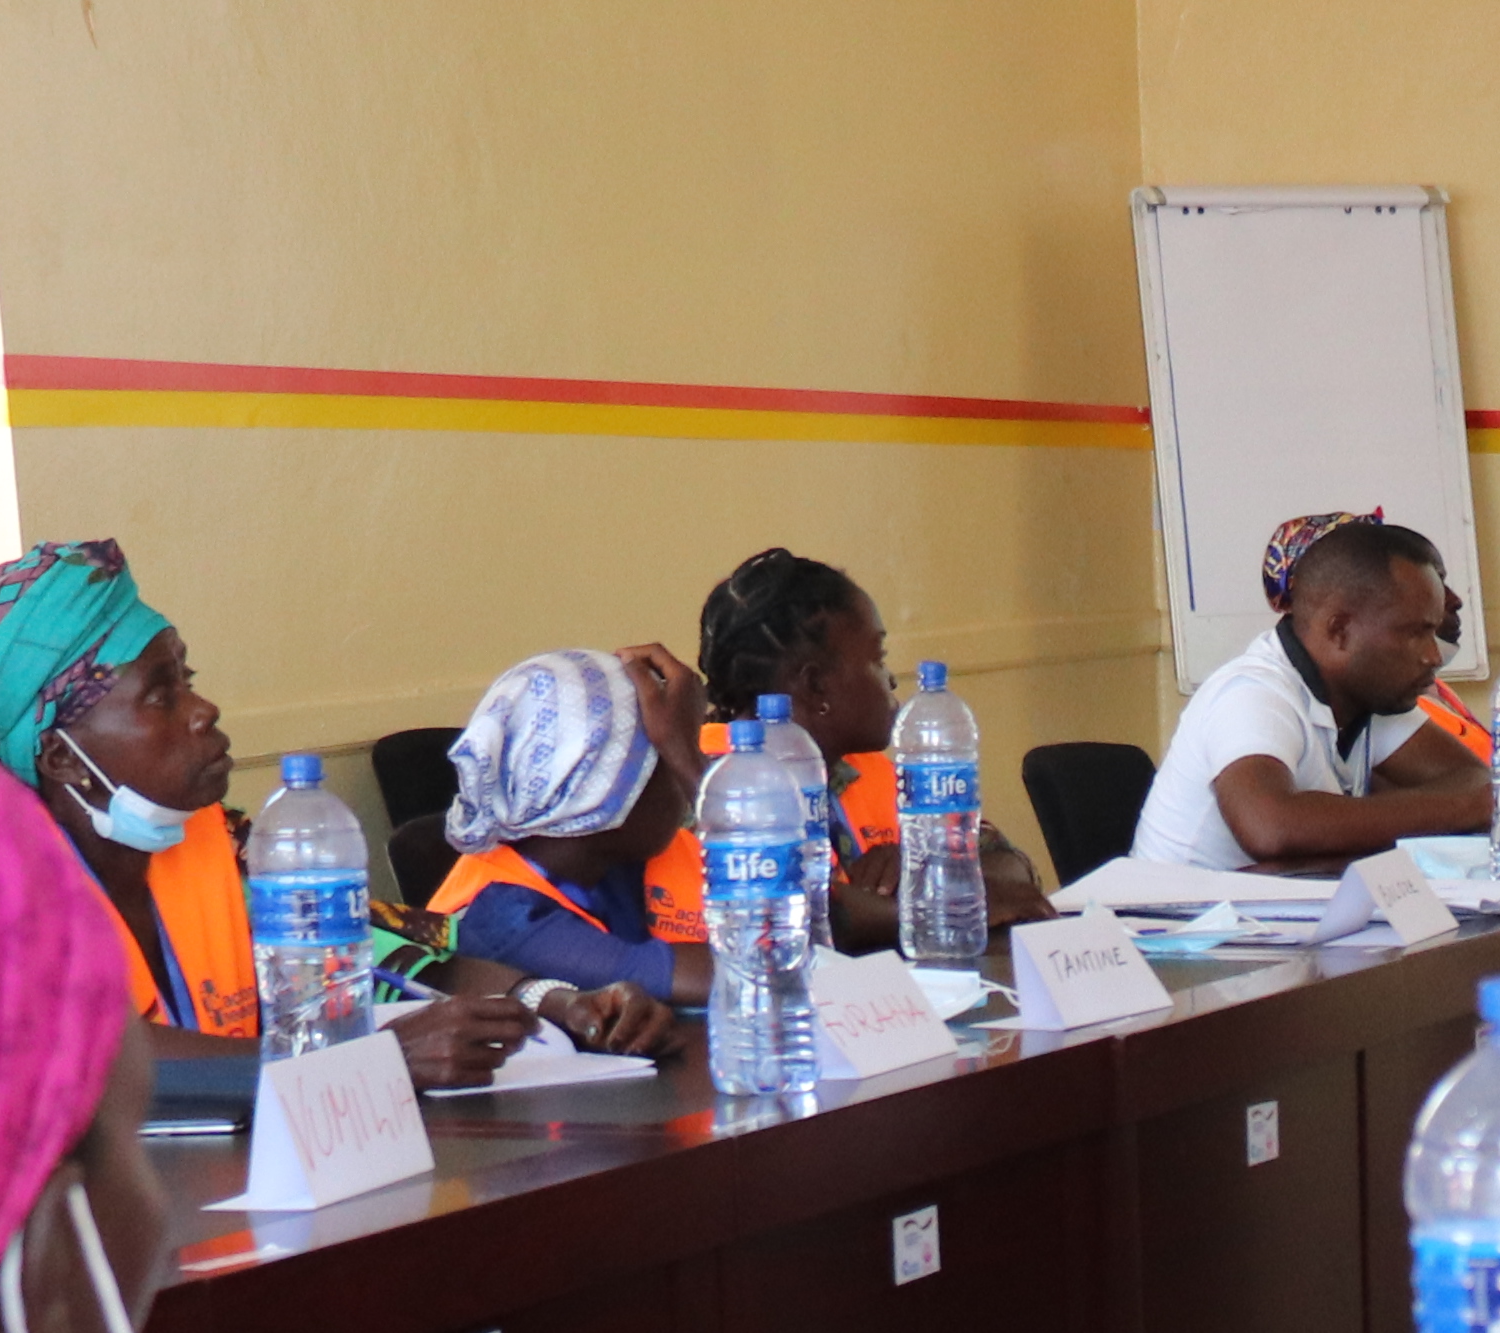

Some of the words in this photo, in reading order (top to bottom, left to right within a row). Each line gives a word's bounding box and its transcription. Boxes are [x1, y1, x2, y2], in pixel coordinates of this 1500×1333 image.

[930, 774, 968, 801] Life
[725, 854, 778, 881] Life
[1048, 946, 1129, 983] TANTINE
